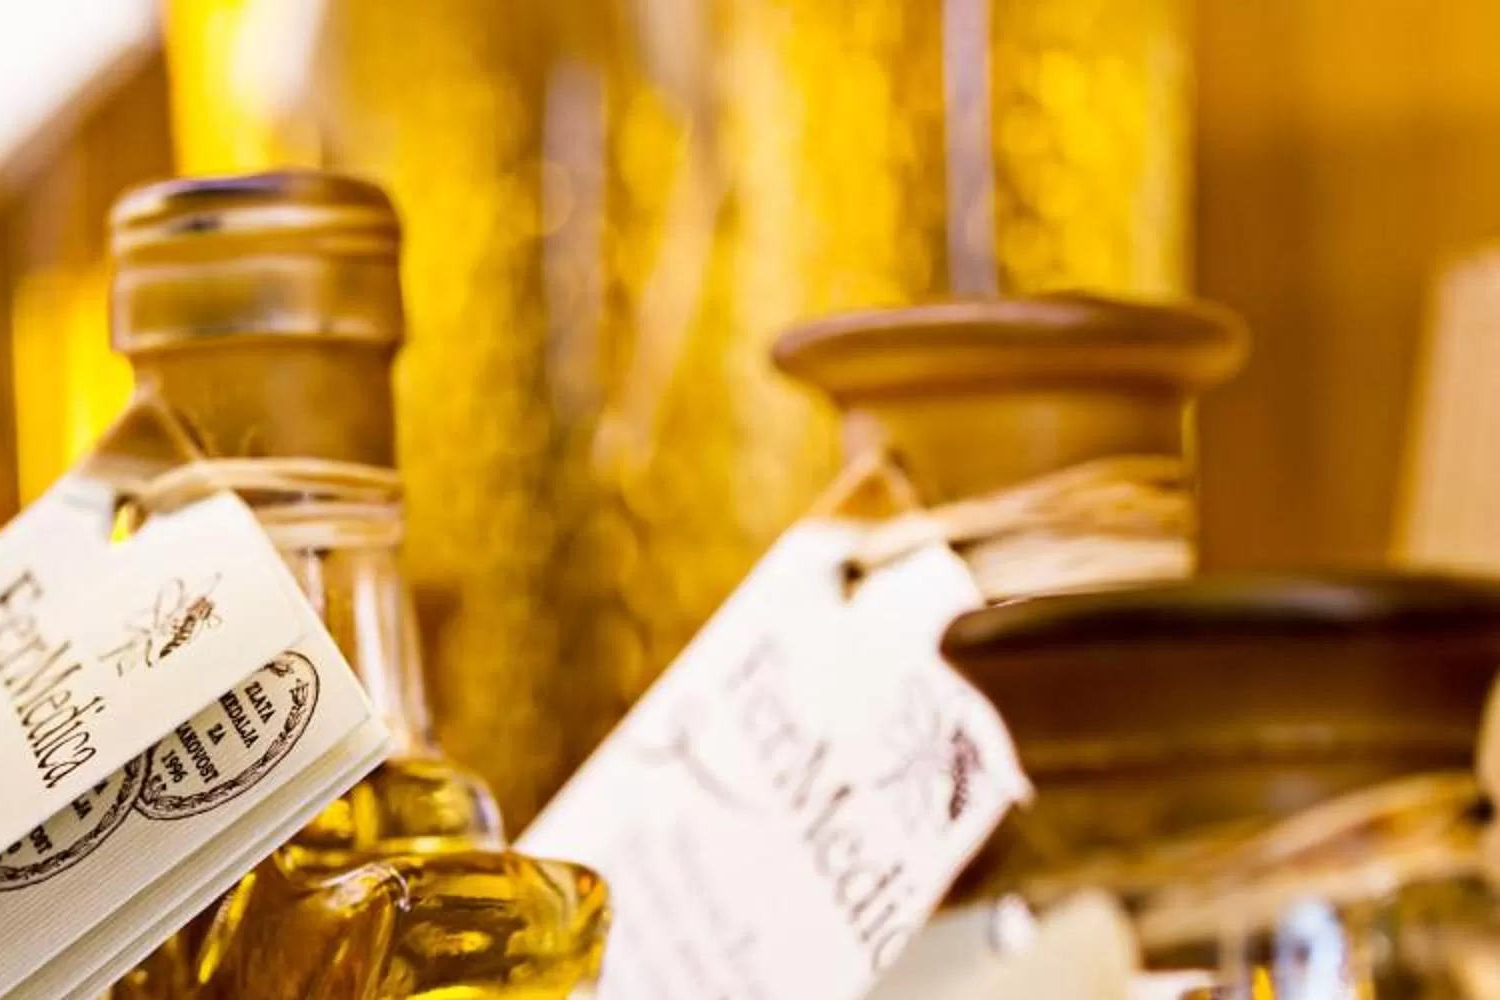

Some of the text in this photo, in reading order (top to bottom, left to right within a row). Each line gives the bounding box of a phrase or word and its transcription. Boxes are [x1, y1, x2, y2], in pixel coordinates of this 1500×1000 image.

[244, 680, 276, 724] ZLATA
[207, 723, 226, 745] ZA
[161, 748, 188, 783] 1996
